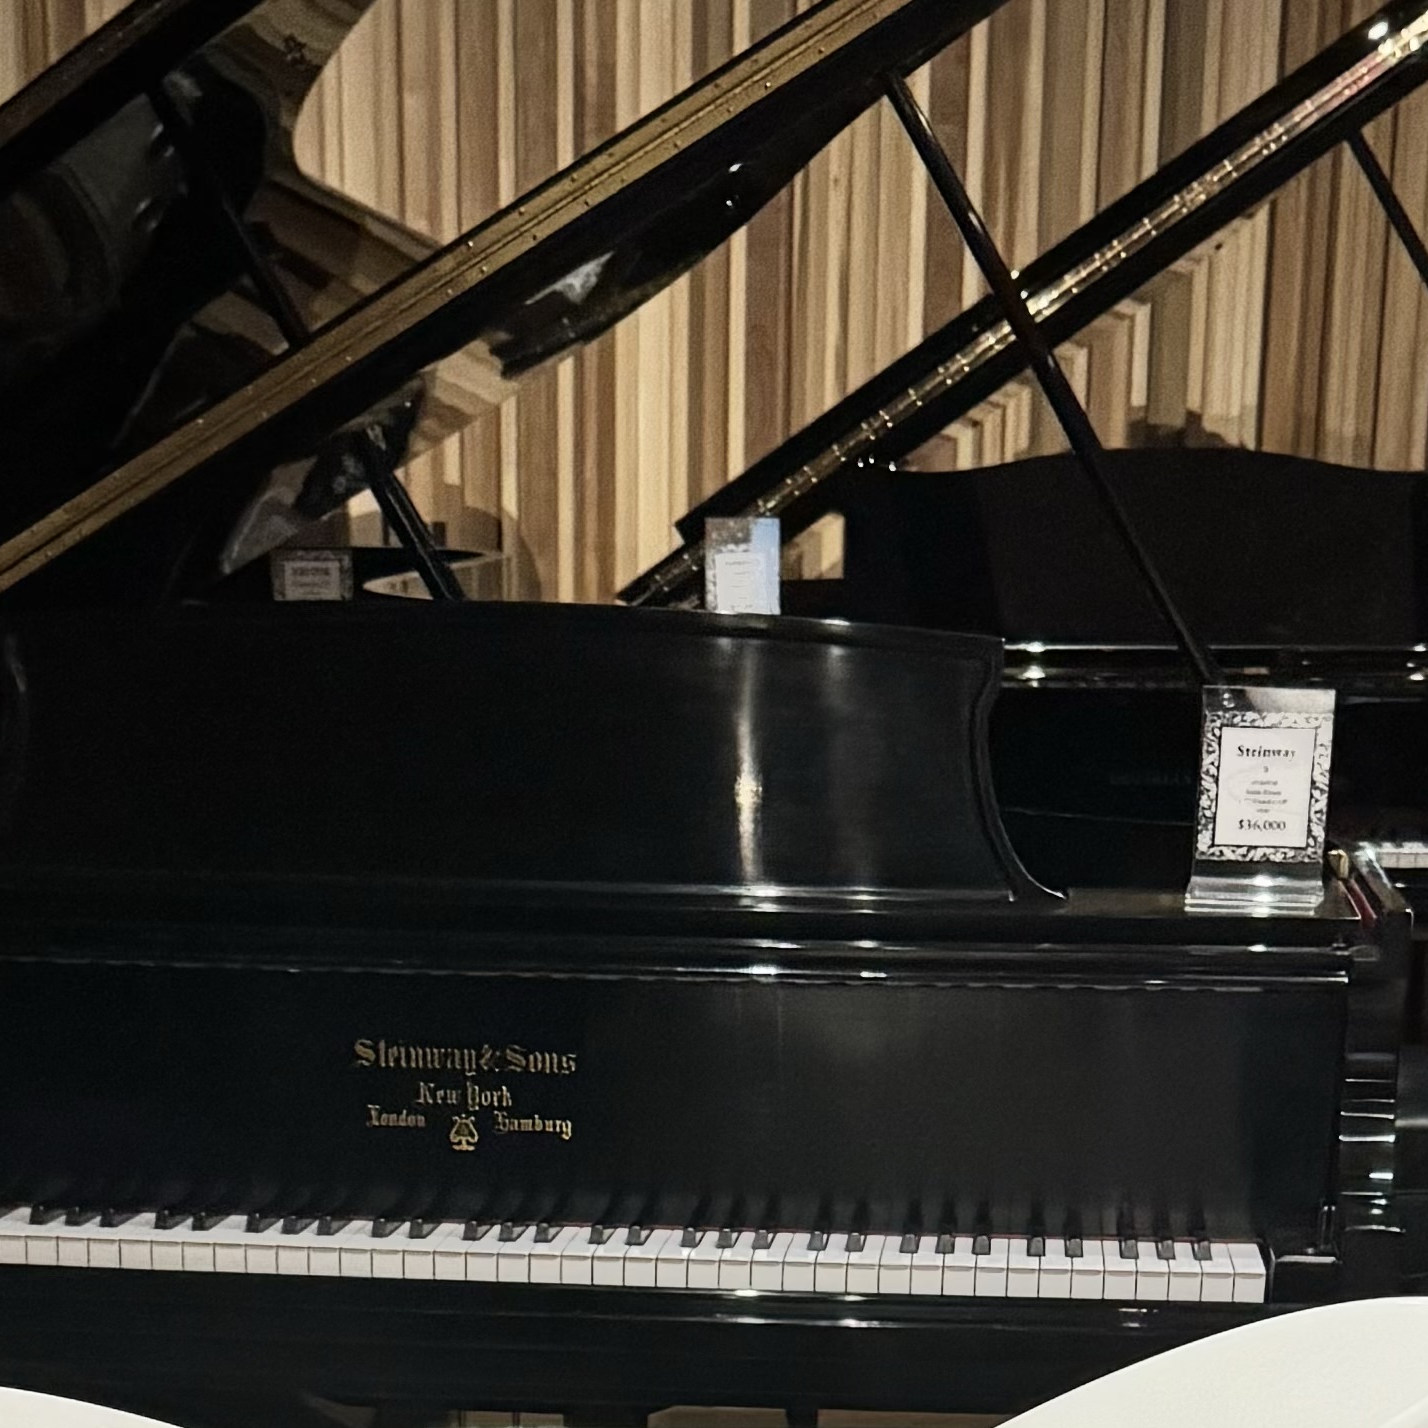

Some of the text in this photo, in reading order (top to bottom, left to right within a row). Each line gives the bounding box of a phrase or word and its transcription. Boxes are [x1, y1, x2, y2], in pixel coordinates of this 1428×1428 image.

[1236, 745, 1297, 761] Steinway
[1238, 819, 1287, 832] $36,000
[353, 1039, 478, 1076] Steinway
[504, 1044, 578, 1075] Sons
[415, 1081, 512, 1111] New York
[366, 1104, 572, 1140] London Hamburg
